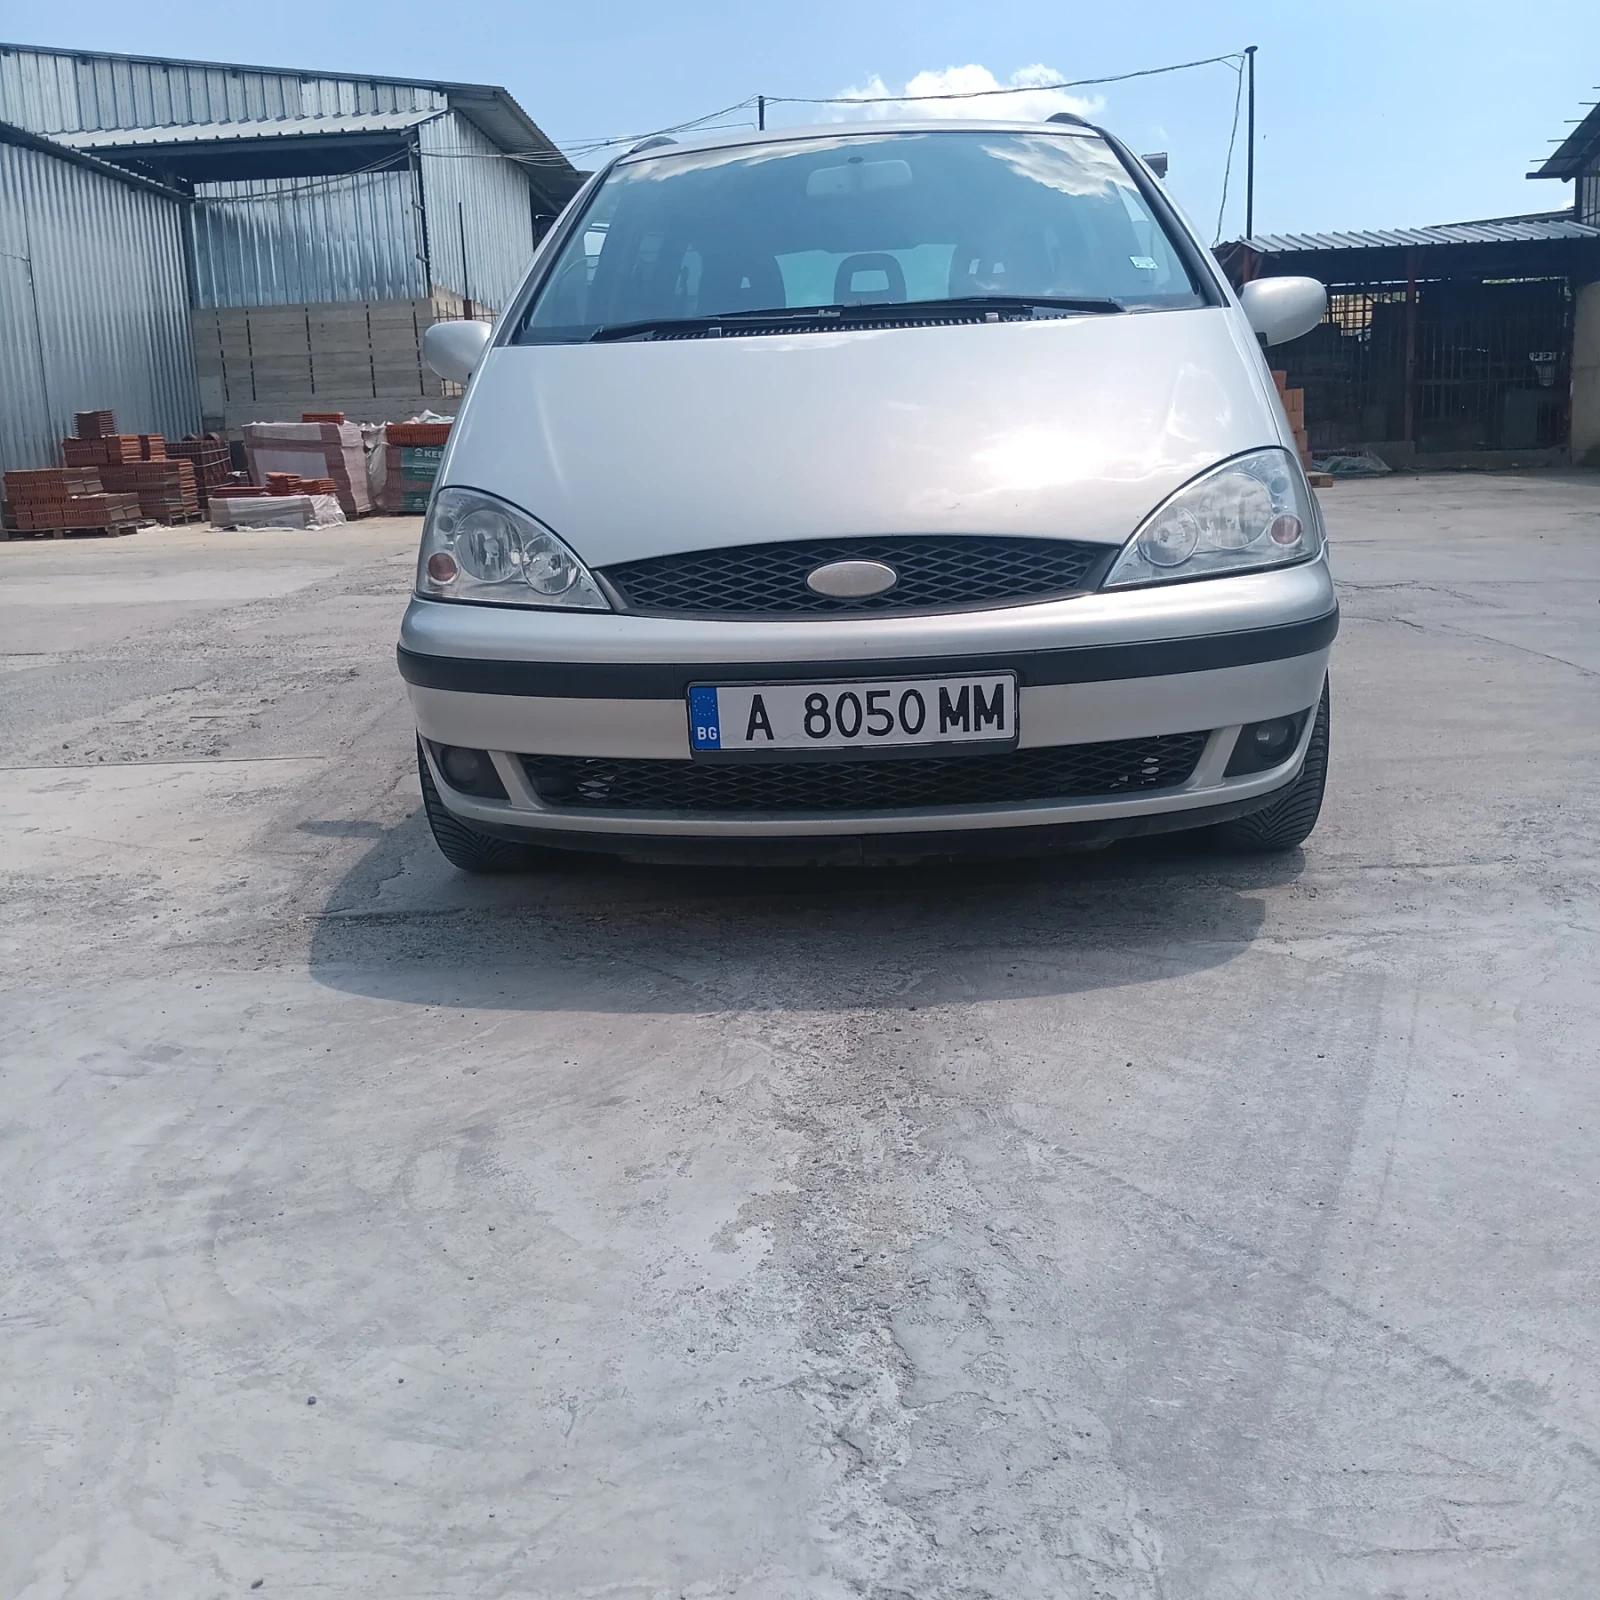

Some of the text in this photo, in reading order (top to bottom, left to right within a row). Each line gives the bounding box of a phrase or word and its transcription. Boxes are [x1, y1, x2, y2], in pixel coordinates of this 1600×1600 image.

[745, 683, 1005, 741] A 8050 MM
[697, 726, 718, 741] BG
